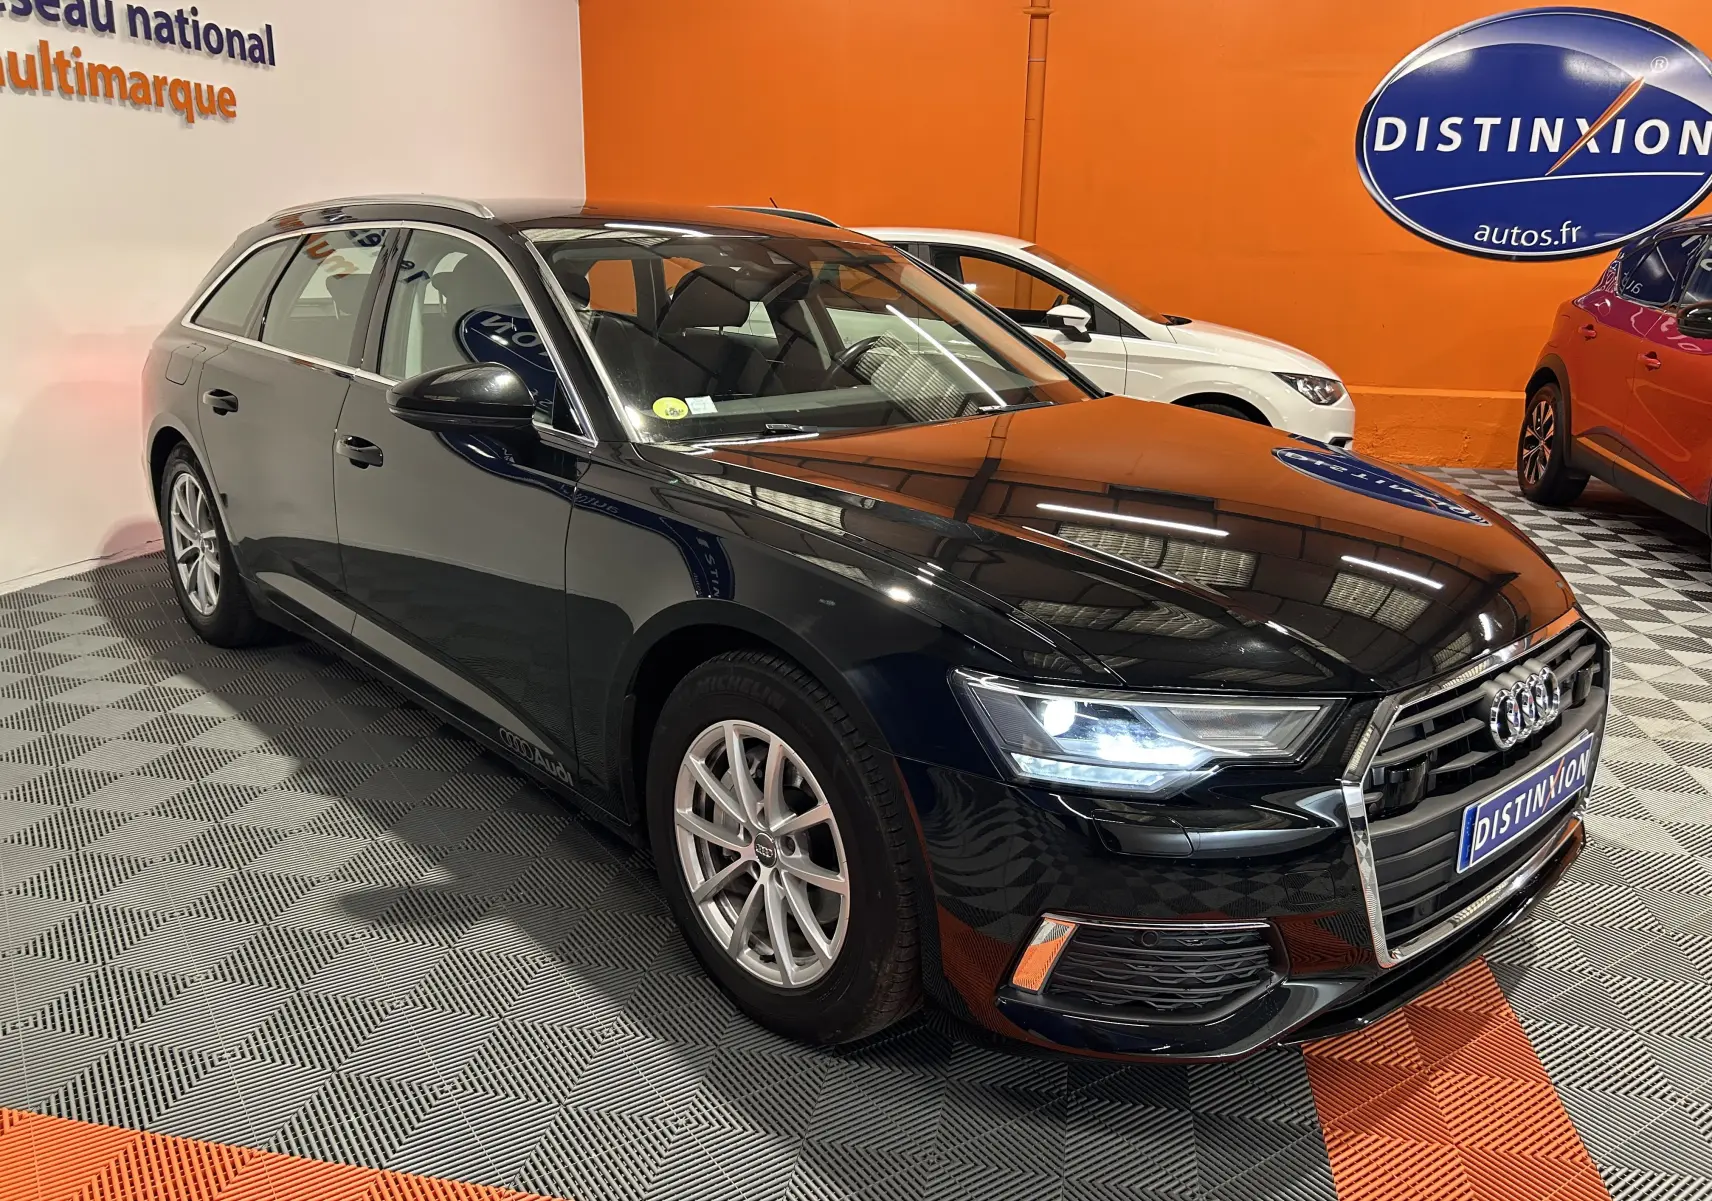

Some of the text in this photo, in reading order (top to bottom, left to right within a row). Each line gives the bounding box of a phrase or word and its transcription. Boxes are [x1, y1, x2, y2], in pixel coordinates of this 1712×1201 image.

[126, 3, 276, 66] national
[0, 39, 237, 123] ultimarque
[1373, 116, 1712, 156] DISTINXION
[1473, 220, 1582, 247] autos.fr
[695, 674, 788, 711] MICHELIN
[534, 747, 575, 787] Audi
[1474, 749, 1591, 851] DISTINXION
